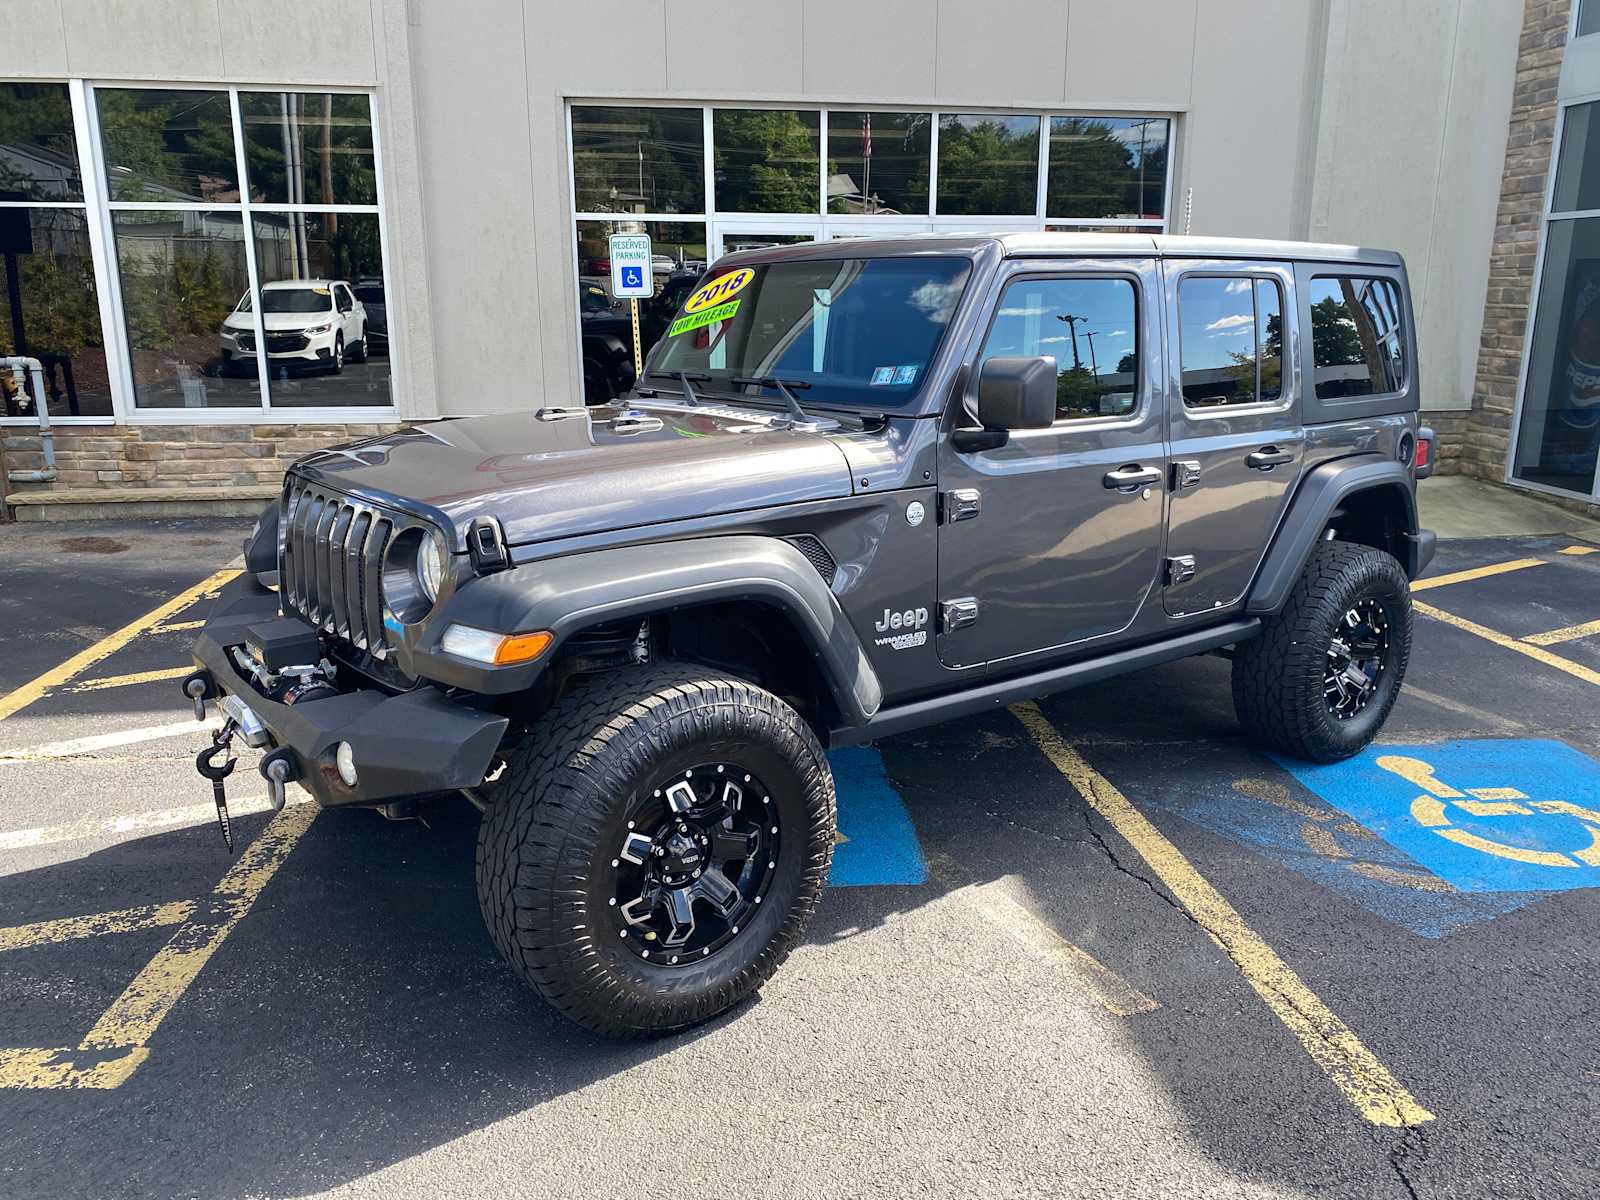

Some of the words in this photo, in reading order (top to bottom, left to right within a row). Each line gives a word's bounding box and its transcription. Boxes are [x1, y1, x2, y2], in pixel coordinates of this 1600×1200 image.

[612, 241, 648, 250] RESERVED
[615, 252, 646, 260] PARKING
[691, 272, 747, 309] 2018
[694, 303, 737, 323] MILEAGE
[875, 607, 928, 632] Jeep
[875, 631, 927, 646] WRANGLER
